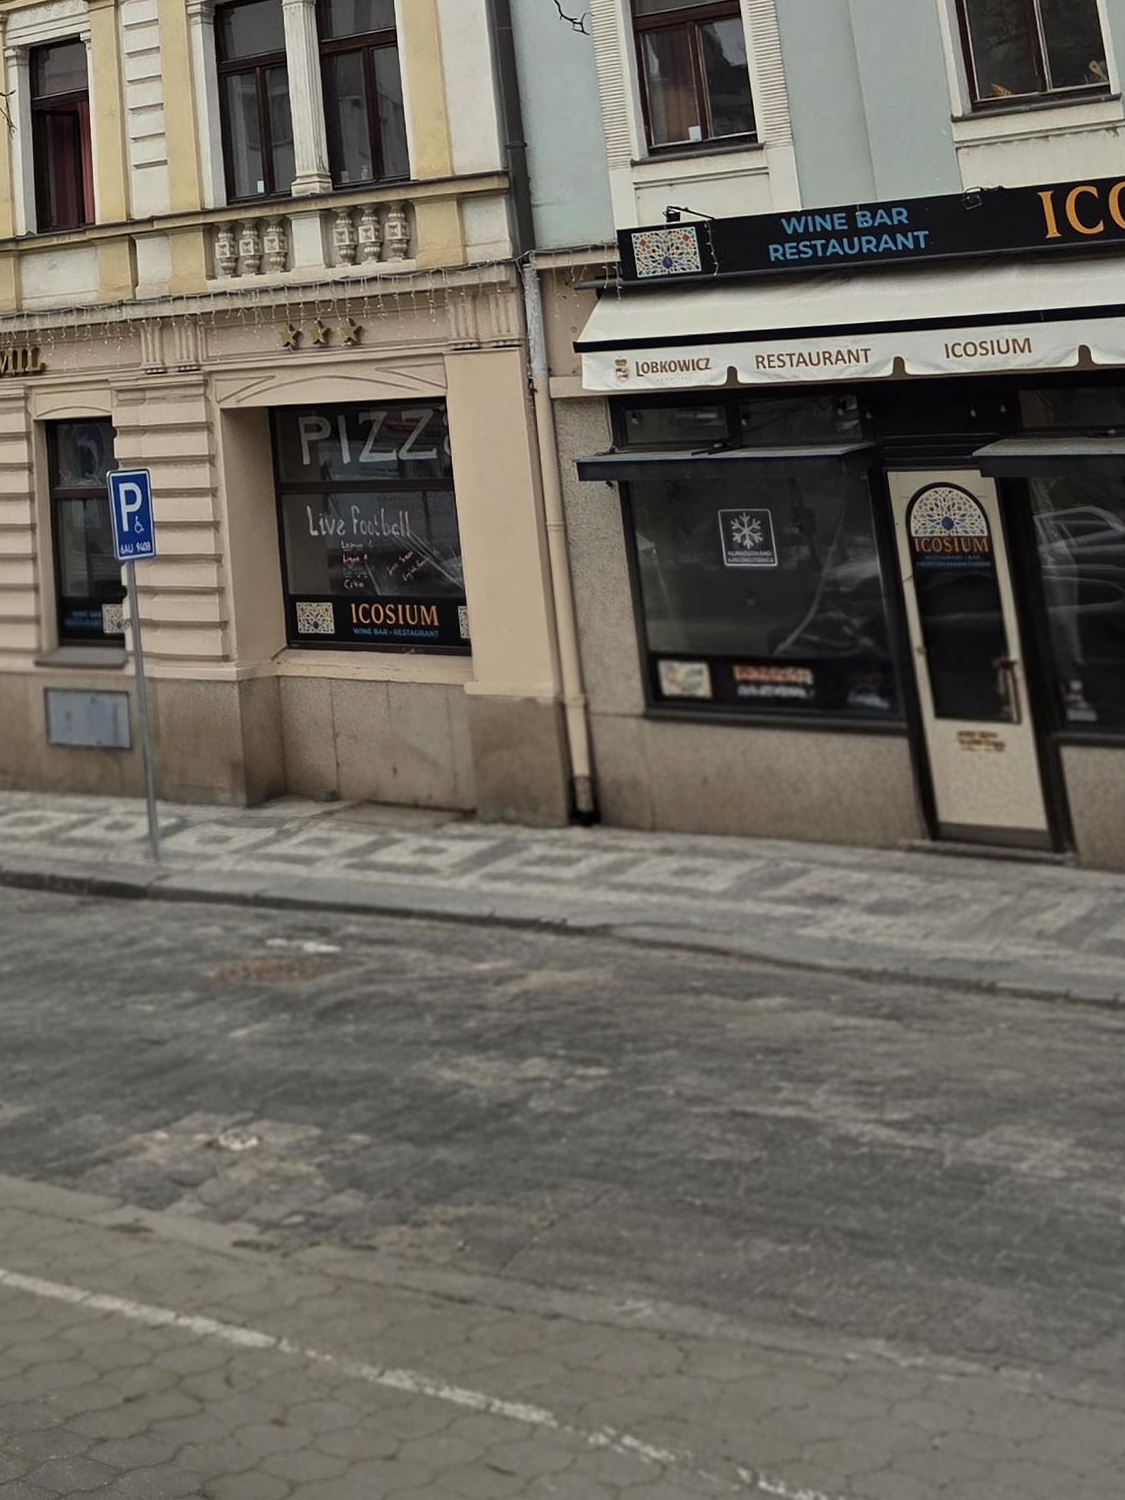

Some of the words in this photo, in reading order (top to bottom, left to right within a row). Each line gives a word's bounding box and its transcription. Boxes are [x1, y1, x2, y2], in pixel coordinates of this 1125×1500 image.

[781, 212, 848, 235] WINE
[856, 207, 909, 229] BAR
[768, 231, 929, 262] RESTAURANT
[755, 348, 871, 369] RESTAURANT
[944, 337, 1032, 359] ICOSIUM
[636, 358, 712, 377] LOBKOWICZ
[298, 408, 452, 465] PIZZ
[118, 482, 143, 532] P
[307, 505, 347, 536] Live
[915, 537, 989, 552] ICOSIUM
[350, 603, 439, 626] ICOSIUM
